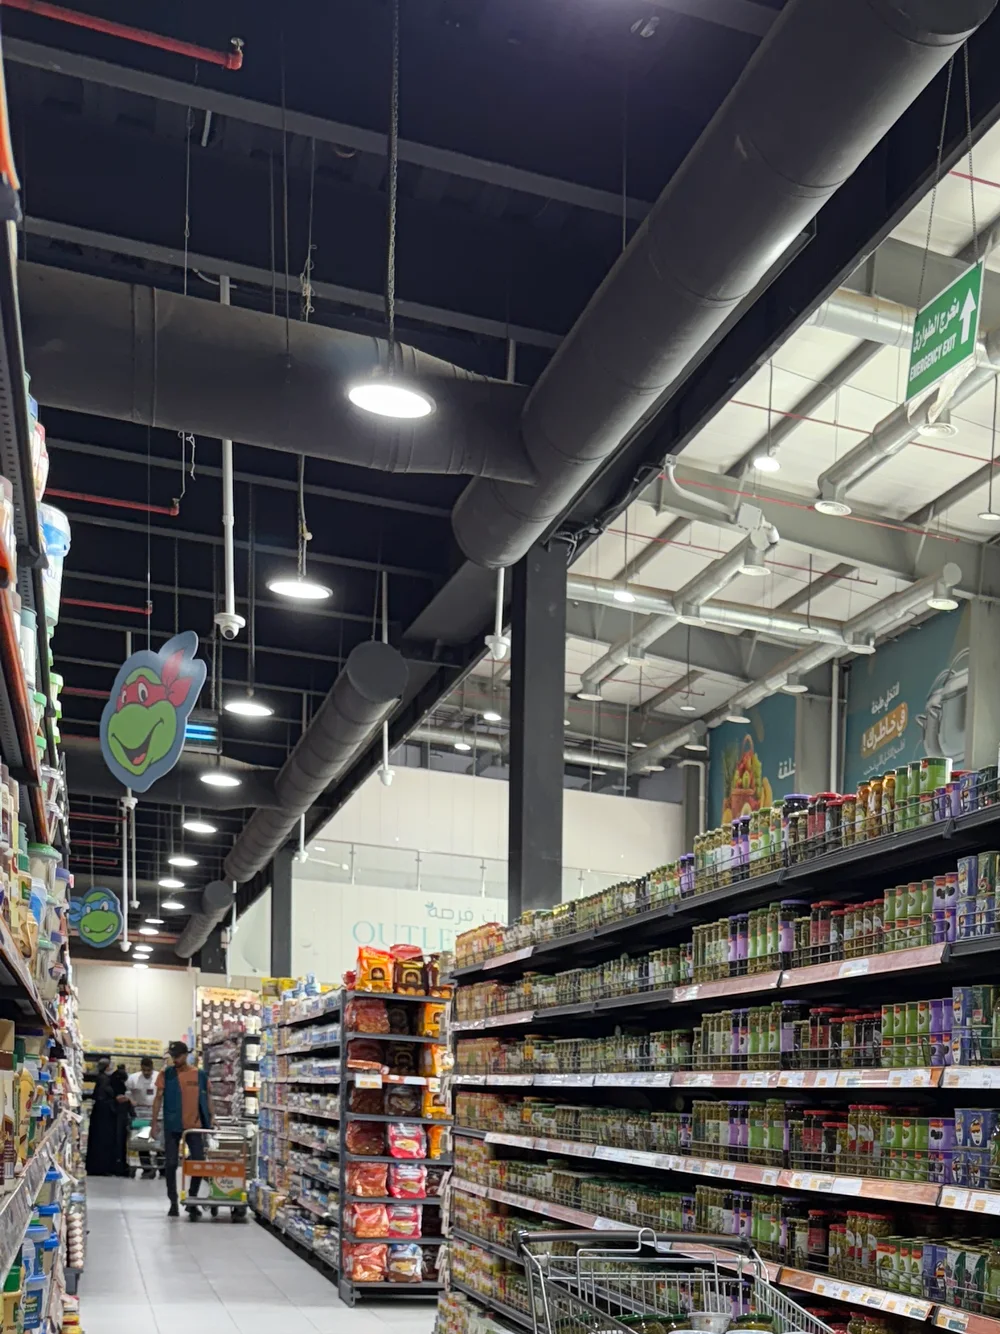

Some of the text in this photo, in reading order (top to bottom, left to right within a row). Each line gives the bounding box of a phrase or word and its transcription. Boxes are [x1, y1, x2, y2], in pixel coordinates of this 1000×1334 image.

[909, 333, 957, 382] EMERGENCY EXIT
[352, 920, 459, 952] OUTLE
